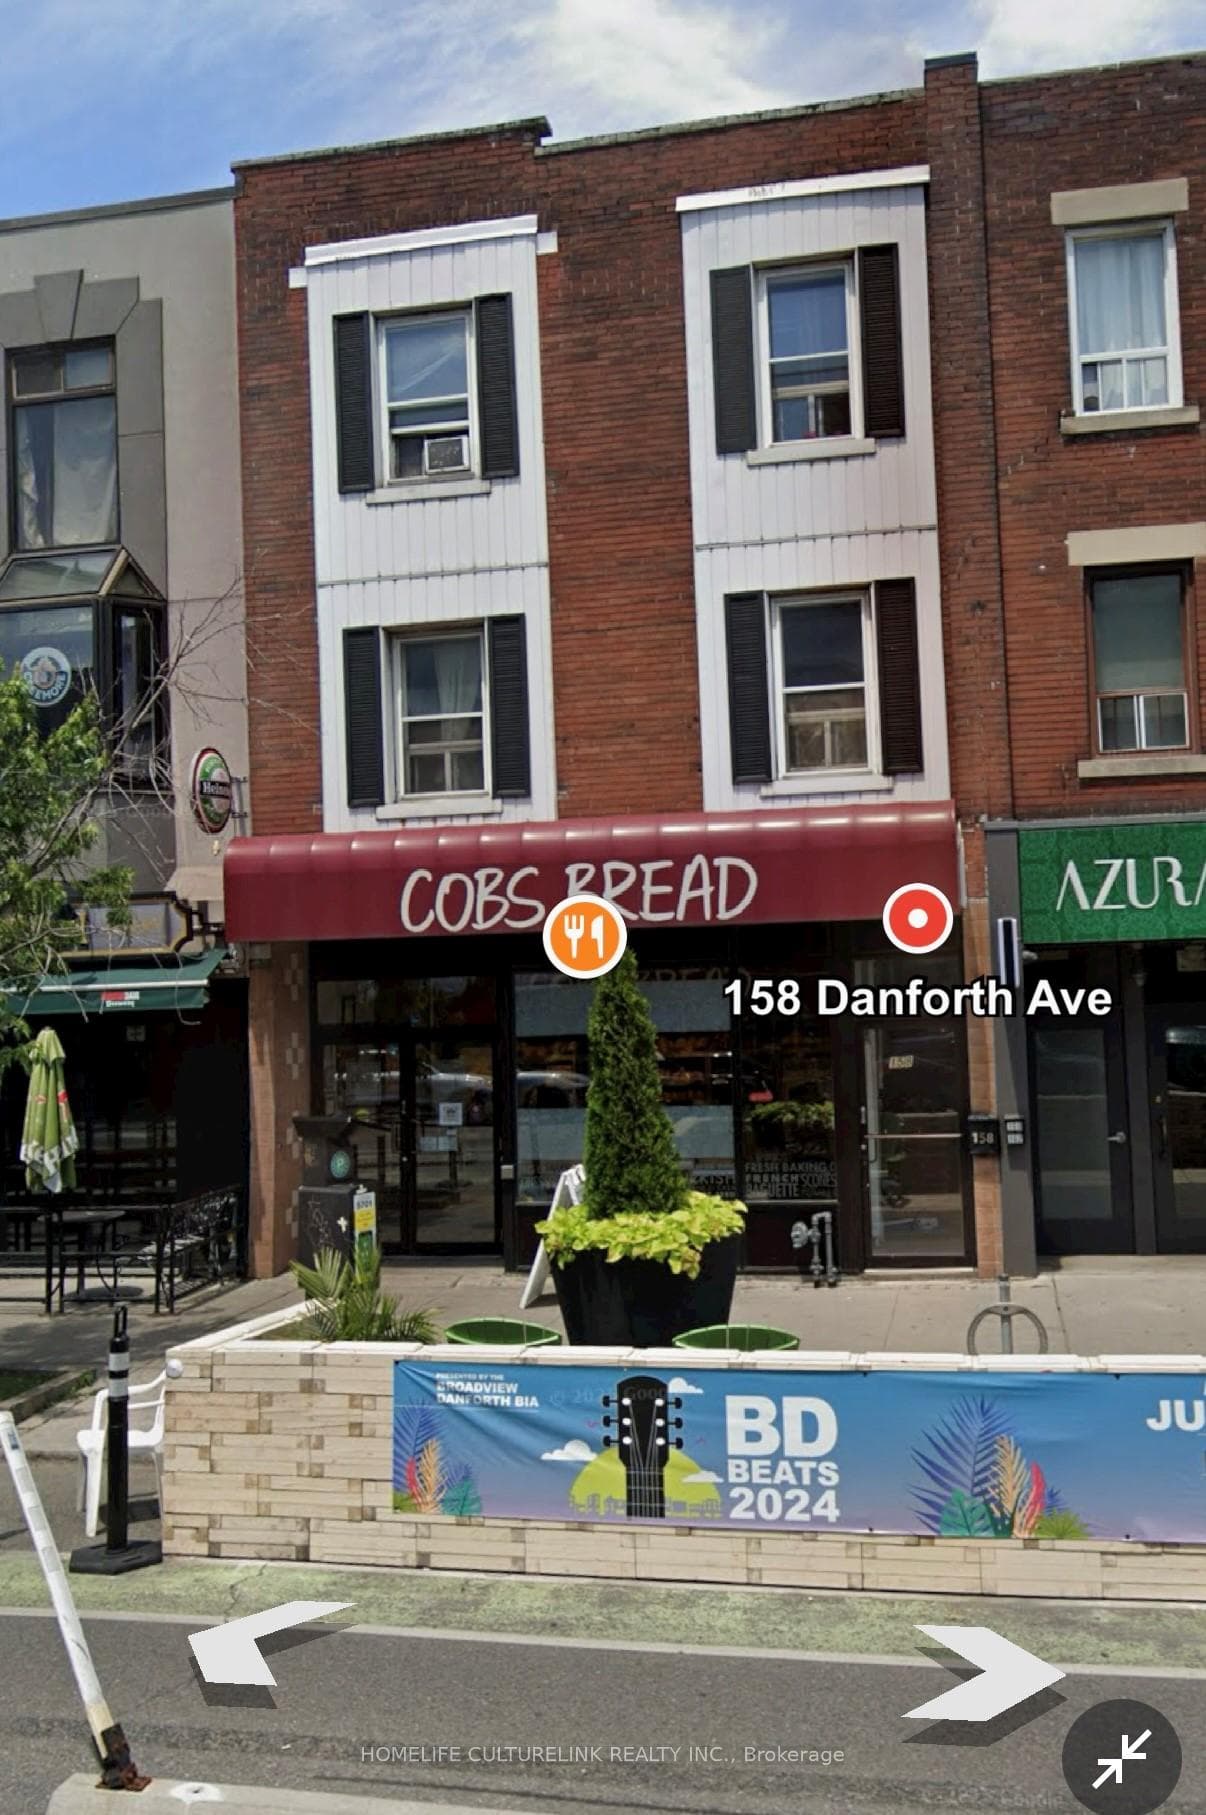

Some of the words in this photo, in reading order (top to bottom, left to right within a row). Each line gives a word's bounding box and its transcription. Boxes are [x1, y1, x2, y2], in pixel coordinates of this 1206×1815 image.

[400, 866, 546, 933] COBS
[971, 1132, 995, 1145] 158
[437, 1380, 519, 1395] BROADVIEW
[437, 1392, 511, 1408] DANFORTH
[514, 1395, 540, 1408] BIA
[725, 1394, 839, 1457] BD
[727, 1458, 841, 1487] BEATS
[729, 1486, 841, 1523] 2024
